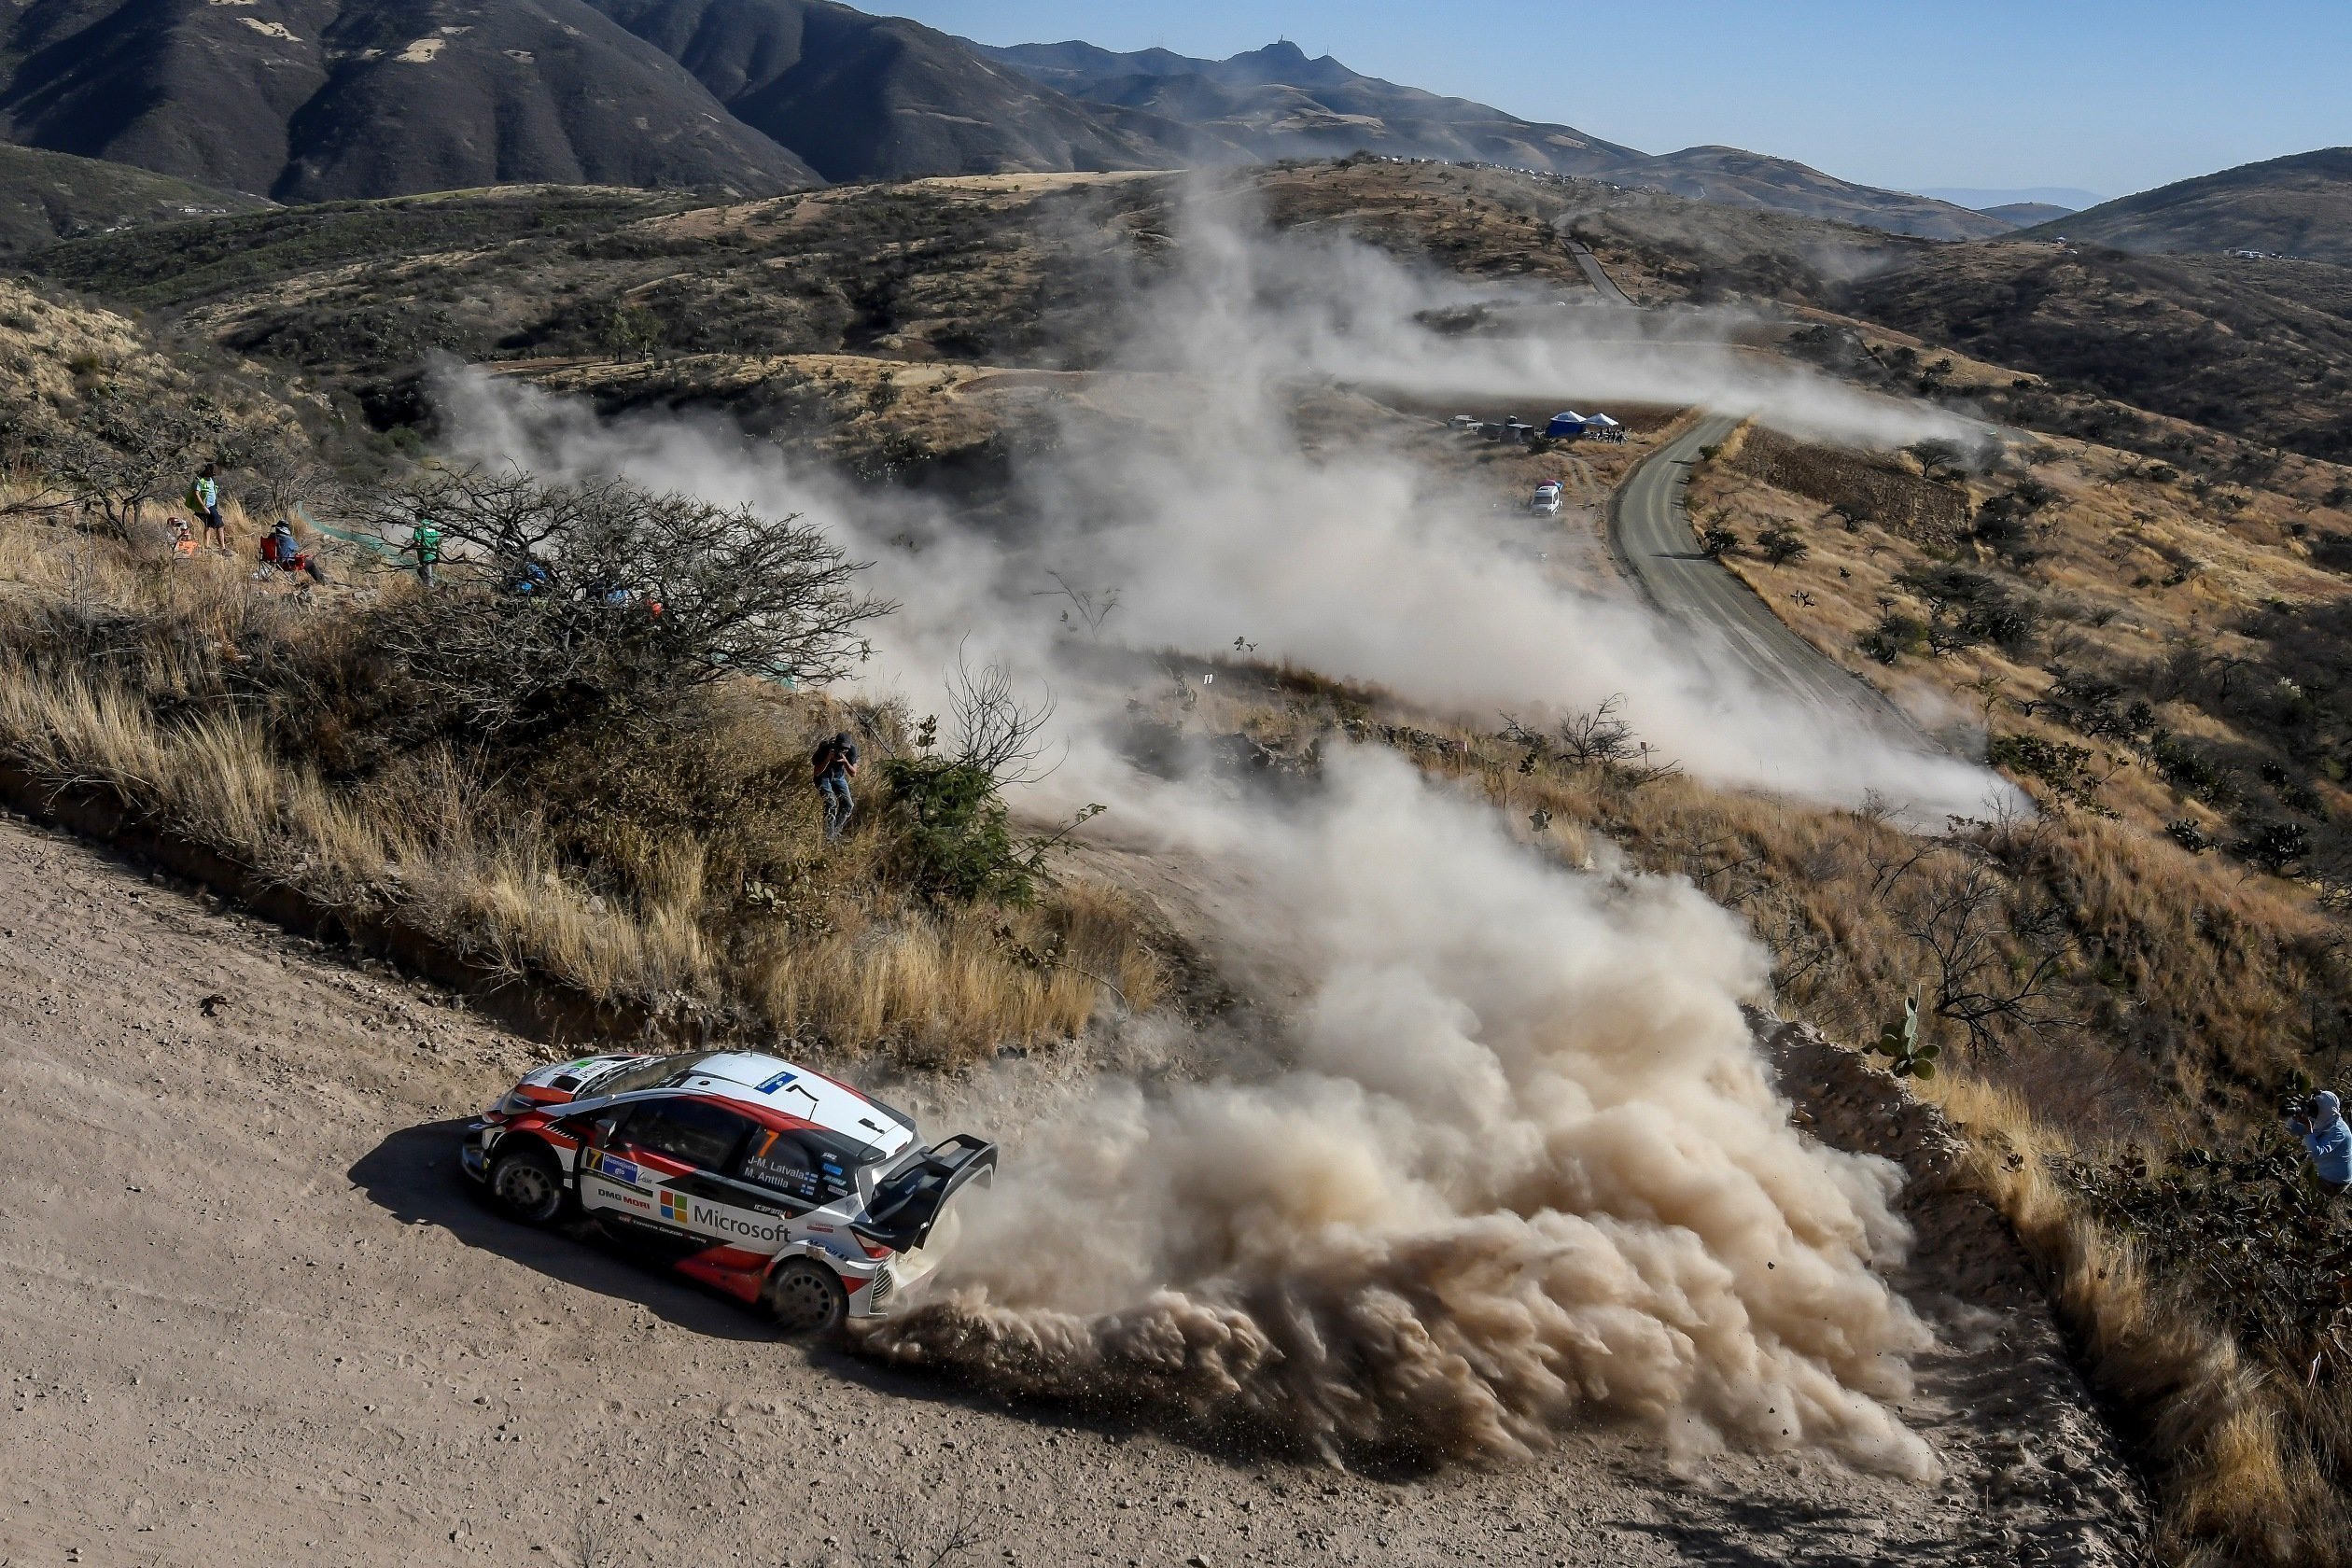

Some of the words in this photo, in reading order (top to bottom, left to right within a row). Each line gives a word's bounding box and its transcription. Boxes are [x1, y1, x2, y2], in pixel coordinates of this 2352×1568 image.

[759, 1129, 779, 1157] 7
[590, 1149, 602, 1169] 7
[605, 1155, 637, 1172] Guanajuato
[748, 1155, 768, 1169] J-M.
[770, 1161, 805, 1181] Latvala
[744, 1167, 755, 1178] M.
[757, 1171, 789, 1188] Anttila
[597, 1188, 623, 1202] DMG
[623, 1195, 651, 1211] MORI
[693, 1205, 791, 1243] Microsoft
